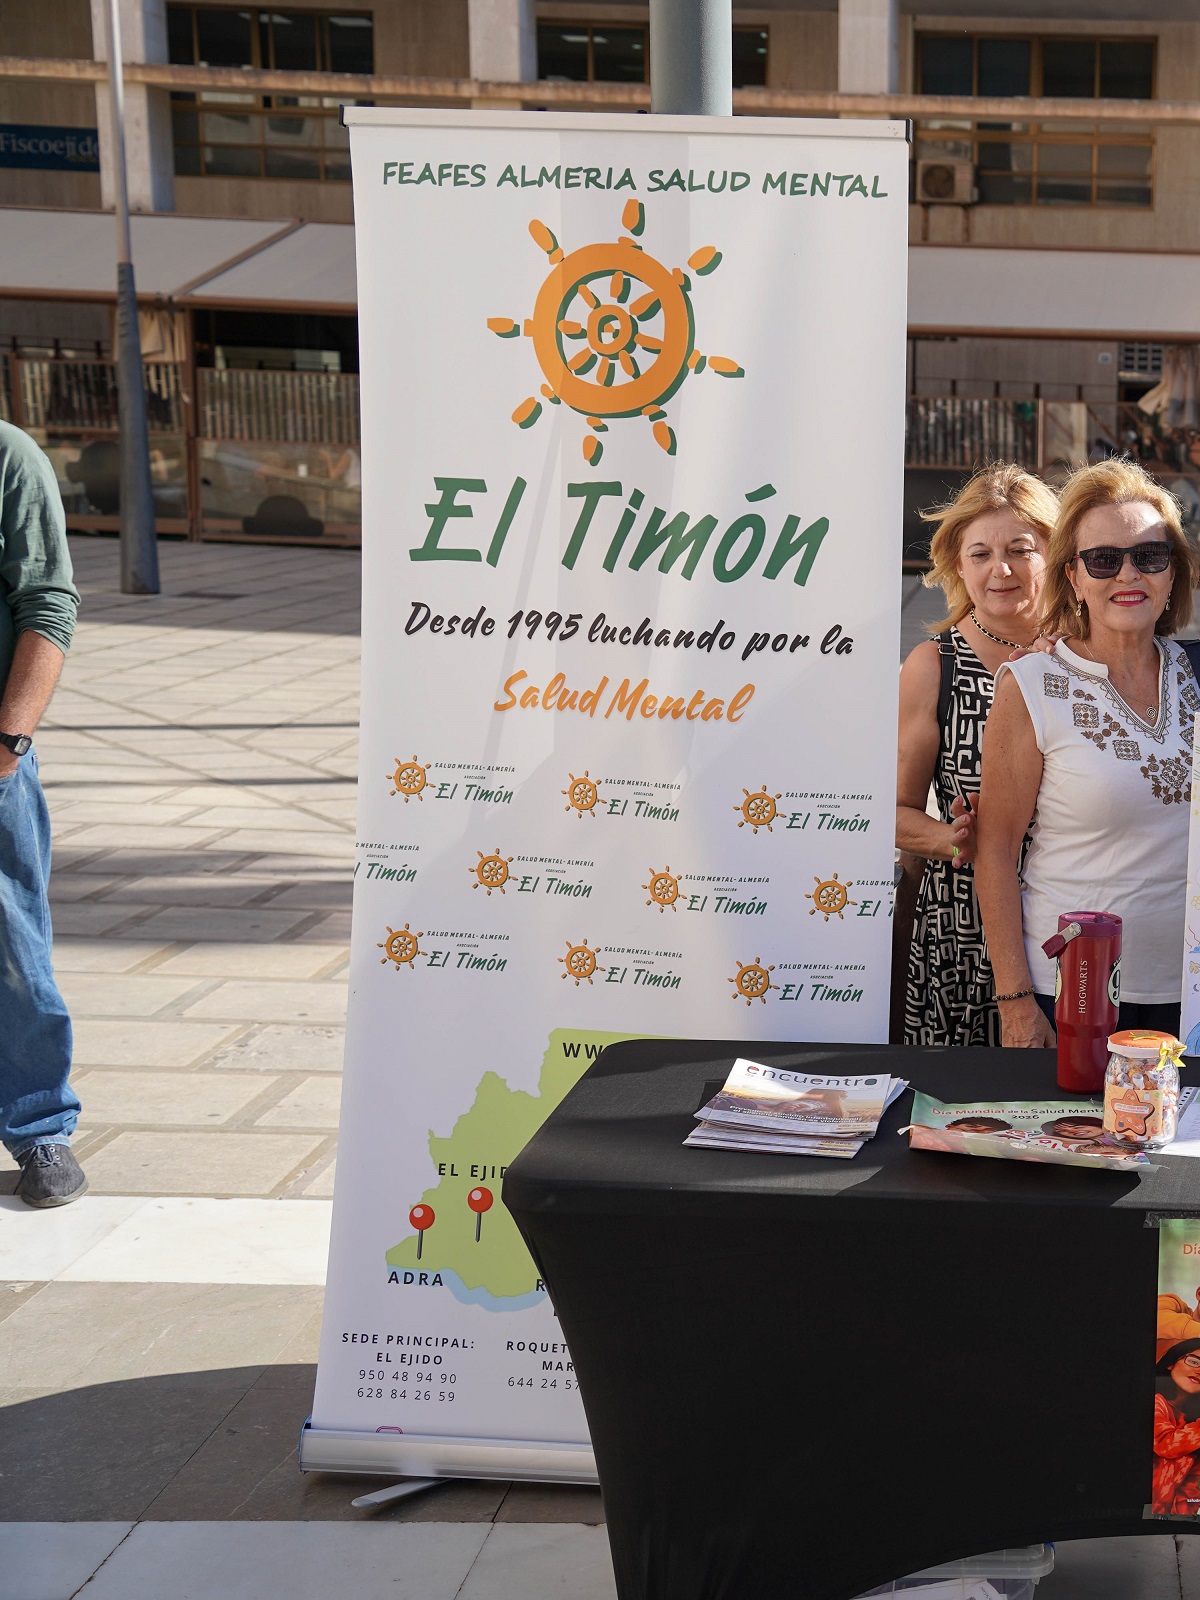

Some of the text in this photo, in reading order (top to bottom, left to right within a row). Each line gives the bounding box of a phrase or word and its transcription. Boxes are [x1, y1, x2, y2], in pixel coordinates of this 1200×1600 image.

[383, 162, 888, 199] FEAFES ALMERIA SALUD MENTAL
[409, 476, 830, 587] El Timón
[404, 601, 853, 662] Desde 1995 luchando por la
[493, 669, 757, 724] Salud Mental
[435, 783, 513, 804] El Timón
[607, 799, 680, 822] El Timón
[786, 813, 870, 832] El Timón
[366, 863, 418, 882] Timón
[518, 876, 593, 898] El Timón
[687, 895, 767, 915] El Timón
[857, 900, 881, 917] El
[427, 951, 507, 972] El Timón
[605, 966, 681, 989] El Timón
[1078, 960, 1088, 1014] HOGWARTS
[779, 984, 864, 1002] El Timón
[746, 1065, 878, 1086] encuentro
[438, 1163, 458, 1176] EL
[387, 1271, 444, 1287] ADRA
[342, 1332, 476, 1349] SEDE PRINCIPAL:
[506, 1341, 568, 1354] ROQUET
[376, 1352, 444, 1366] EL EJIDO
[542, 1360, 574, 1372] MAR
[358, 1369, 457, 1384] 950 48 94 90
[508, 1376, 533, 1388] 644
[541, 1378, 557, 1389] 24
[357, 1387, 455, 1402] 628 84 26 59
